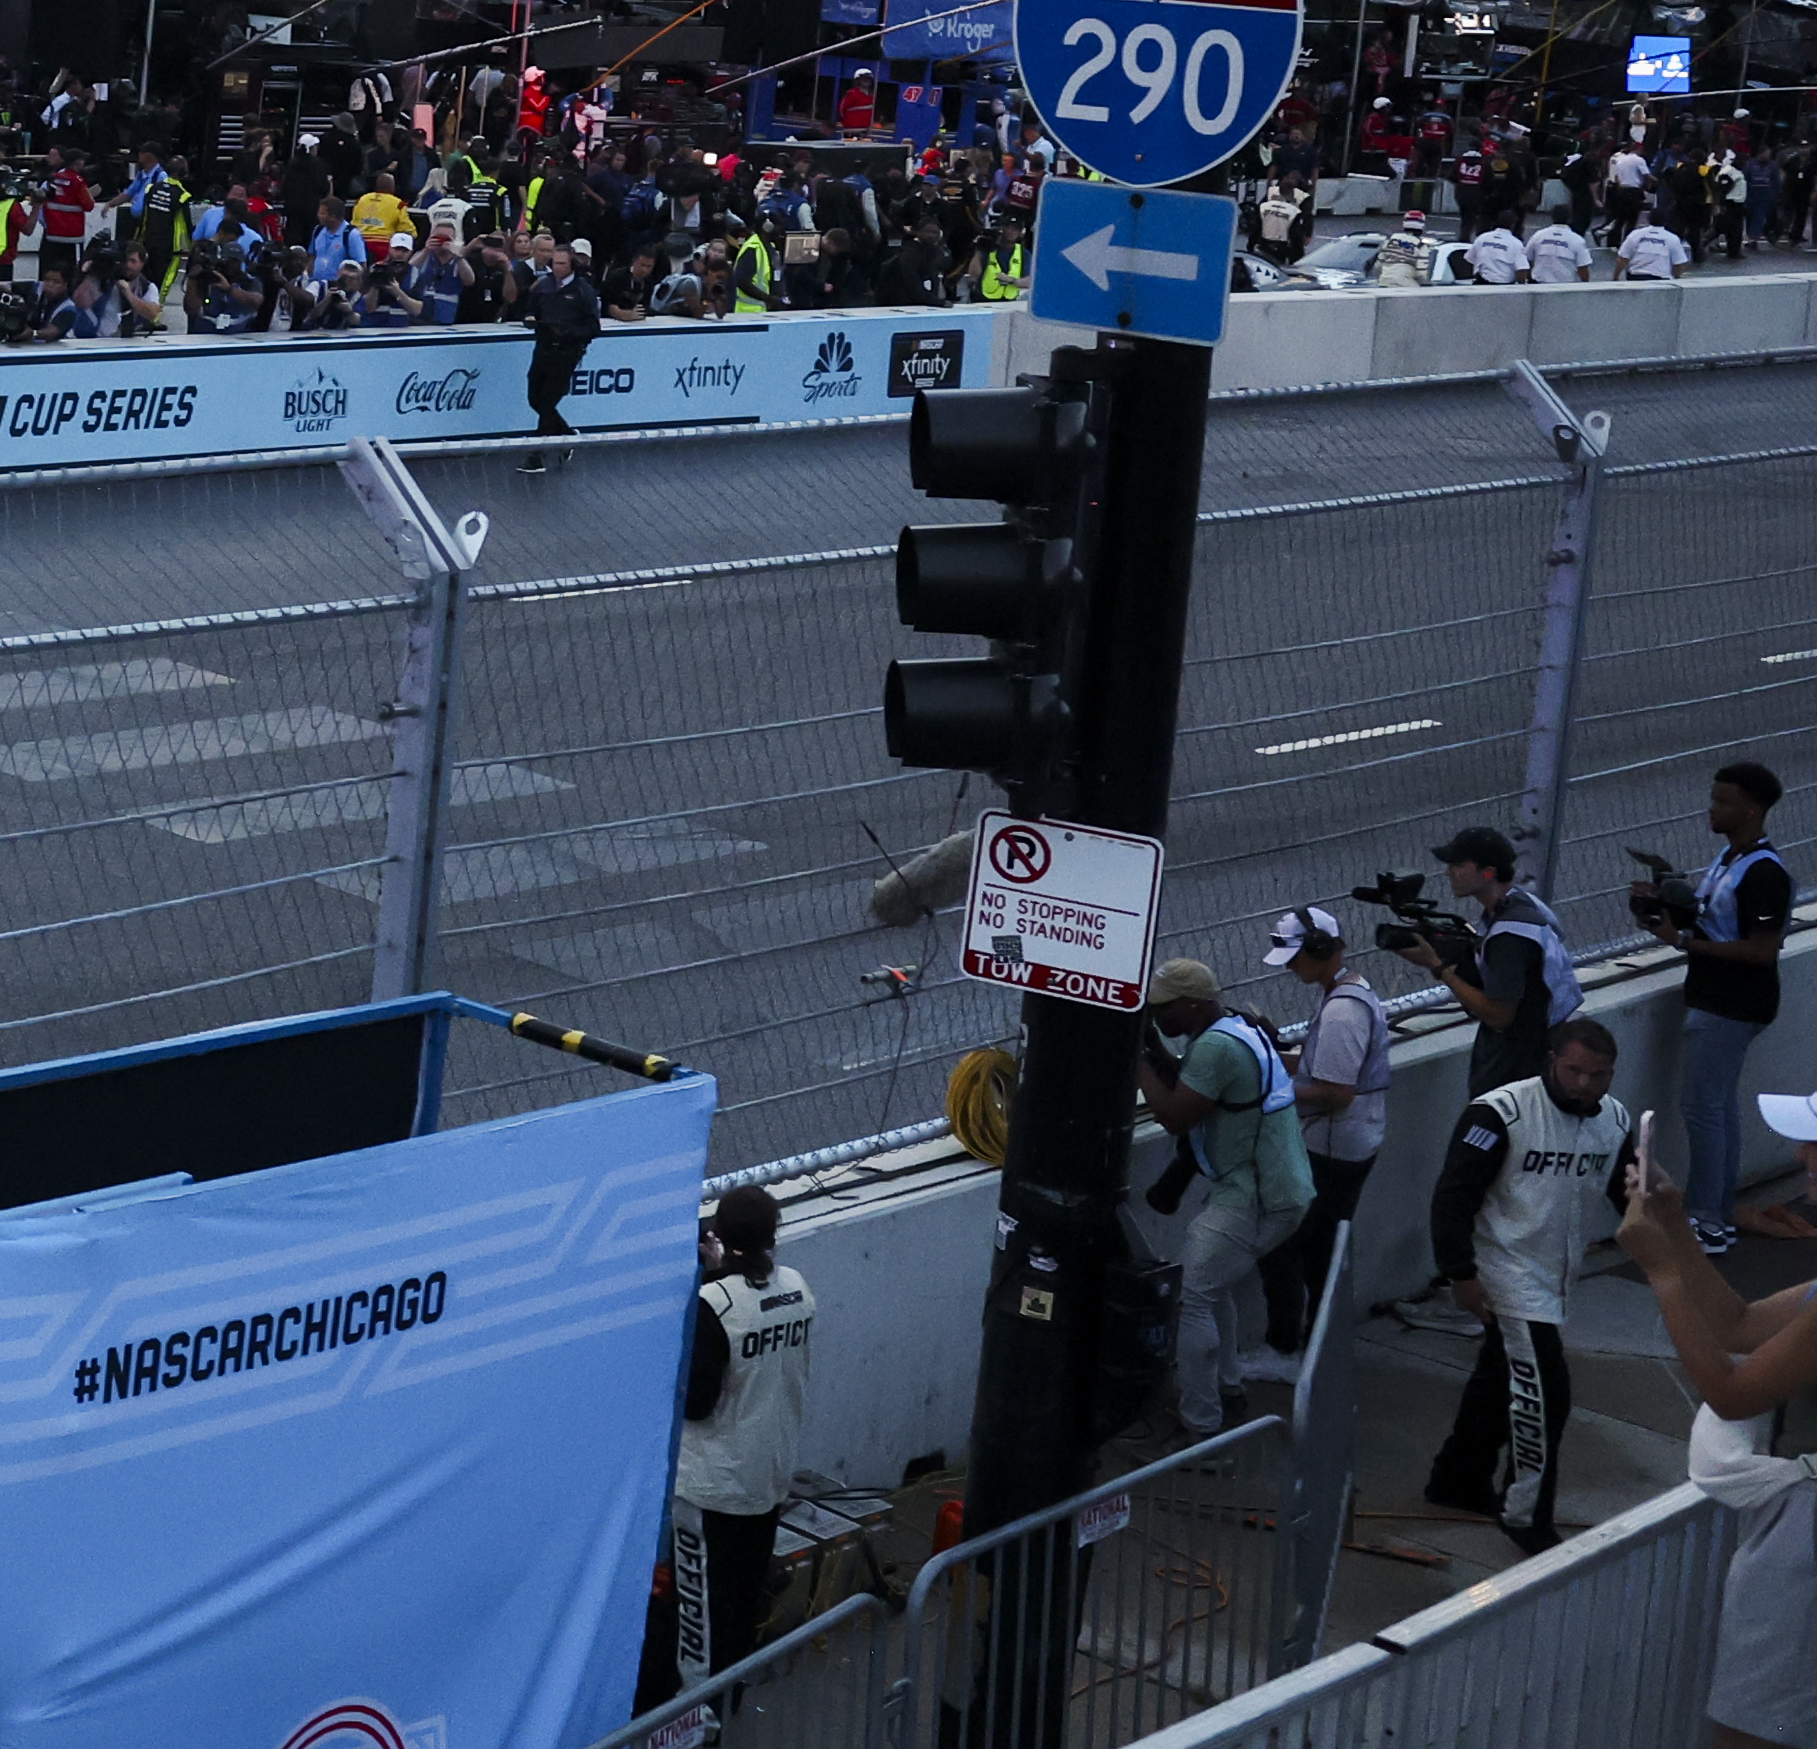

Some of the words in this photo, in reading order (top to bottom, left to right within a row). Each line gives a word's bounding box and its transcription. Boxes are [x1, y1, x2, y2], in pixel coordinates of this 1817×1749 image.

[947, 13, 995, 53] Kroger
[1054, 17, 1246, 136] 290
[569, 367, 636, 396] EICO
[673, 356, 746, 398] xfinity
[802, 371, 863, 405] Sports
[900, 353, 951, 383] xfinity
[9, 391, 80, 438] CUP
[81, 385, 199, 433] SERIES
[284, 388, 348, 419] BUSCH
[396, 367, 481, 416] Coca-Cola
[295, 418, 332, 433] LIGHT
[978, 910, 1005, 929] NO
[1015, 917, 1106, 950] STANDING
[981, 890, 1007, 910] NO
[1016, 898, 1107, 931] STOPPING
[973, 953, 1034, 985] TOW
[1046, 968, 1125, 1005] ZONE
[71, 1269, 449, 1403] #NASCARCHICAGO
[741, 1316, 812, 1360] OFFICI
[1511, 1357, 1543, 1473] OFFICIAL
[678, 1526, 705, 1665] OFFICIAL
